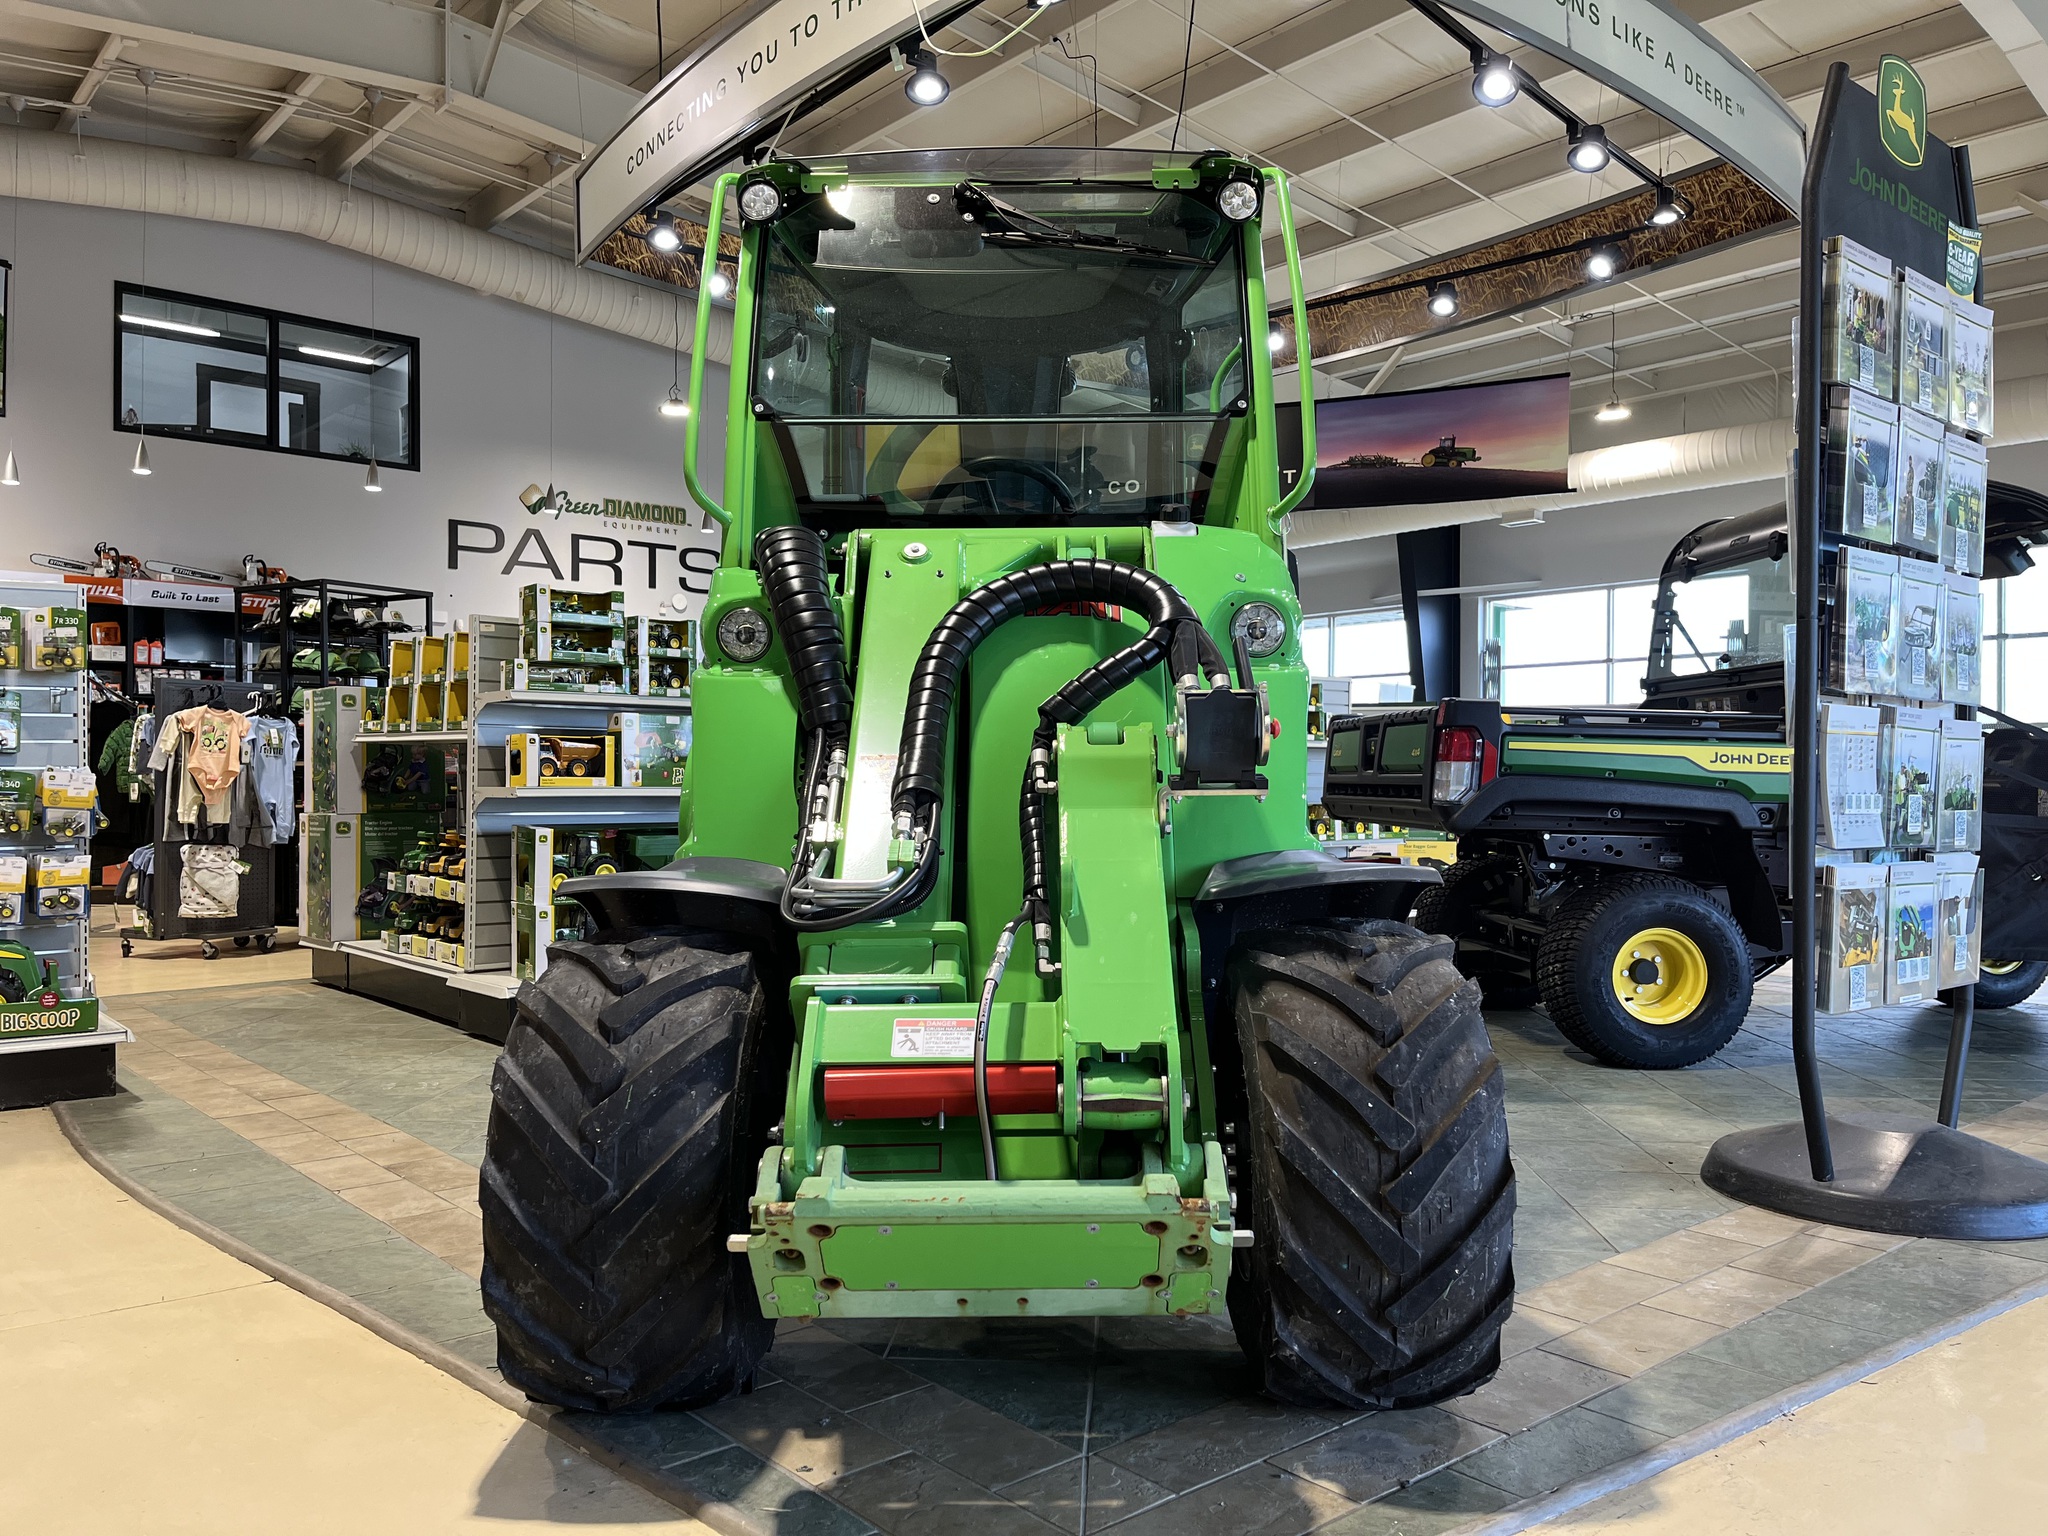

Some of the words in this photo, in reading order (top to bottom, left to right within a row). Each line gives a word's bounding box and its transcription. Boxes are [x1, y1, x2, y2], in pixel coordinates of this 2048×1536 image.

[1612, 15, 1655, 60] LIKE
[1664, 51, 1677, 75] A
[1684, 63, 1735, 117] DEERE
[626, 78, 728, 176] CONNECTING
[736, 39, 779, 84] YOU
[789, 15, 819, 47] TO
[1849, 157, 1896, 207] JOHN
[1897, 182, 1948, 236] DEERE
[1948, 242, 1976, 267] 6-YEAR
[602, 497, 688, 527] DIAMOND
[602, 520, 680, 536] EQUIPMENT
[447, 518, 721, 595] PARTS
[151, 589, 177, 601] Built
[180, 591, 194, 602] To
[196, 593, 220, 604] Last
[241, 596, 278, 608] STIH
[54, 616, 64, 625] 7R
[65, 617, 79, 625] 330
[1709, 751, 1753, 765] JOHN
[1757, 752, 1790, 766] DEE
[5, 780, 21, 788] 340
[1, 1013, 28, 1032] BIG
[28, 1008, 80, 1030] SCOOP
